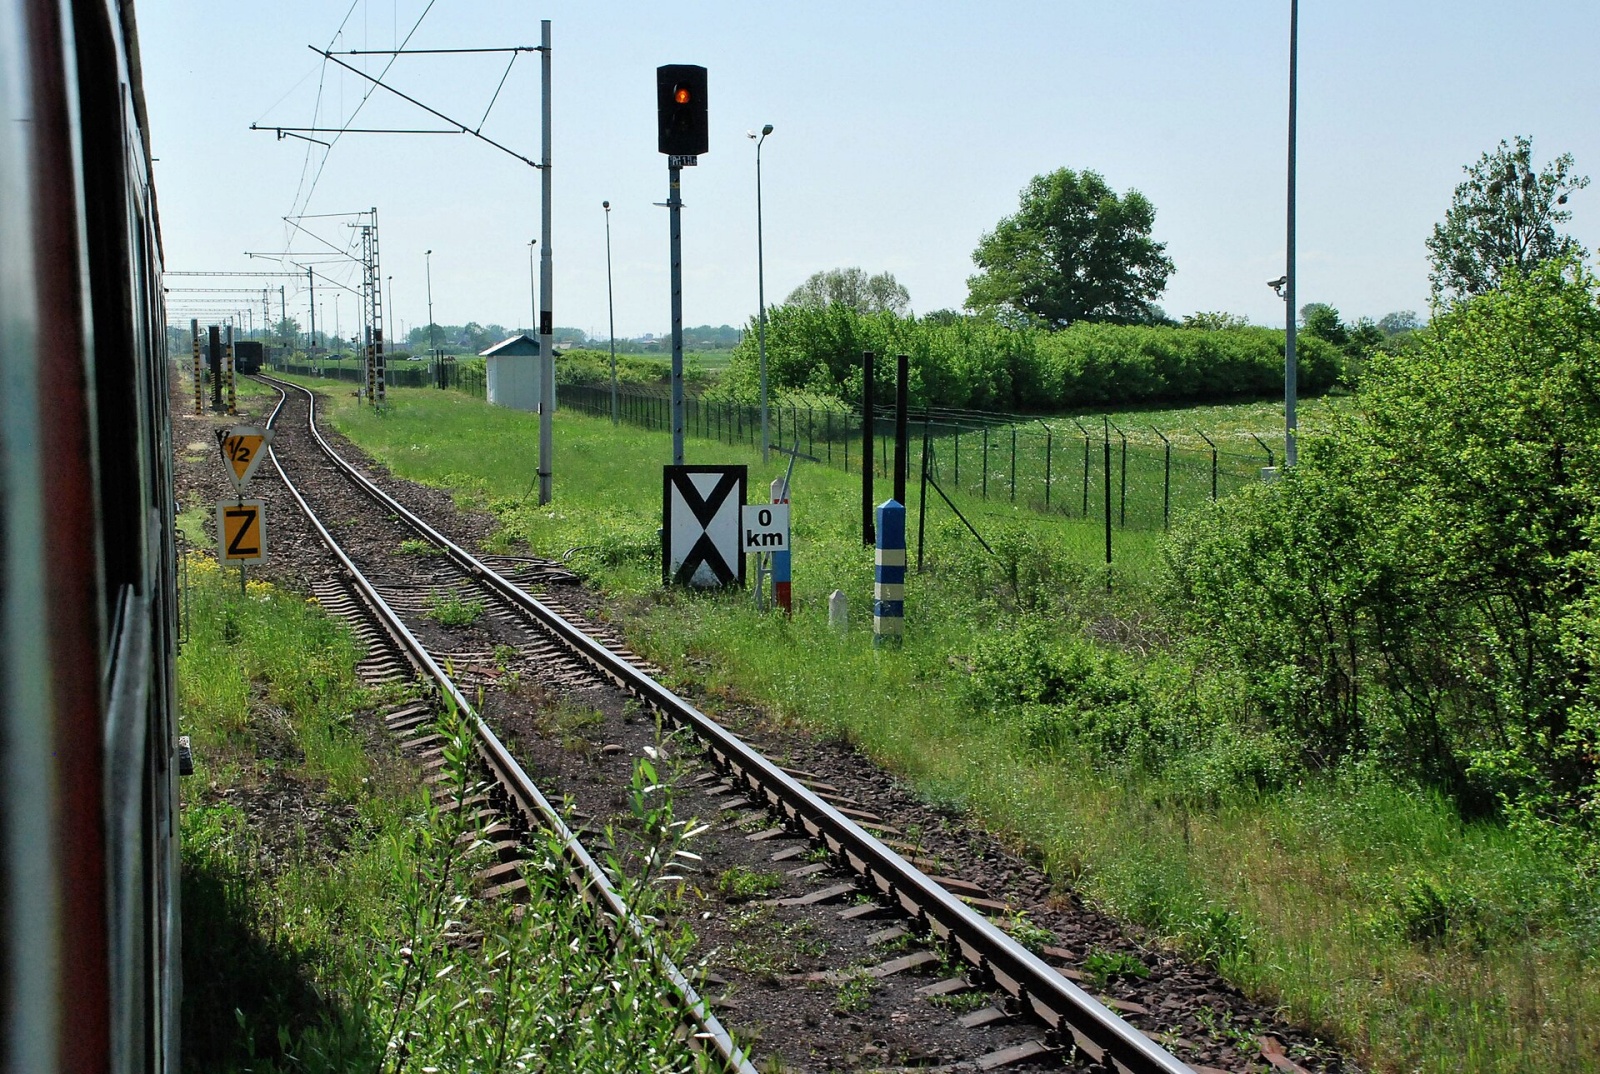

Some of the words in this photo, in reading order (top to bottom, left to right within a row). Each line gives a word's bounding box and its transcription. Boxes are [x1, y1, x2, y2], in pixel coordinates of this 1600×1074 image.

[758, 509, 772, 527] 0
[226, 510, 259, 555] Z
[746, 530, 783, 547] km
